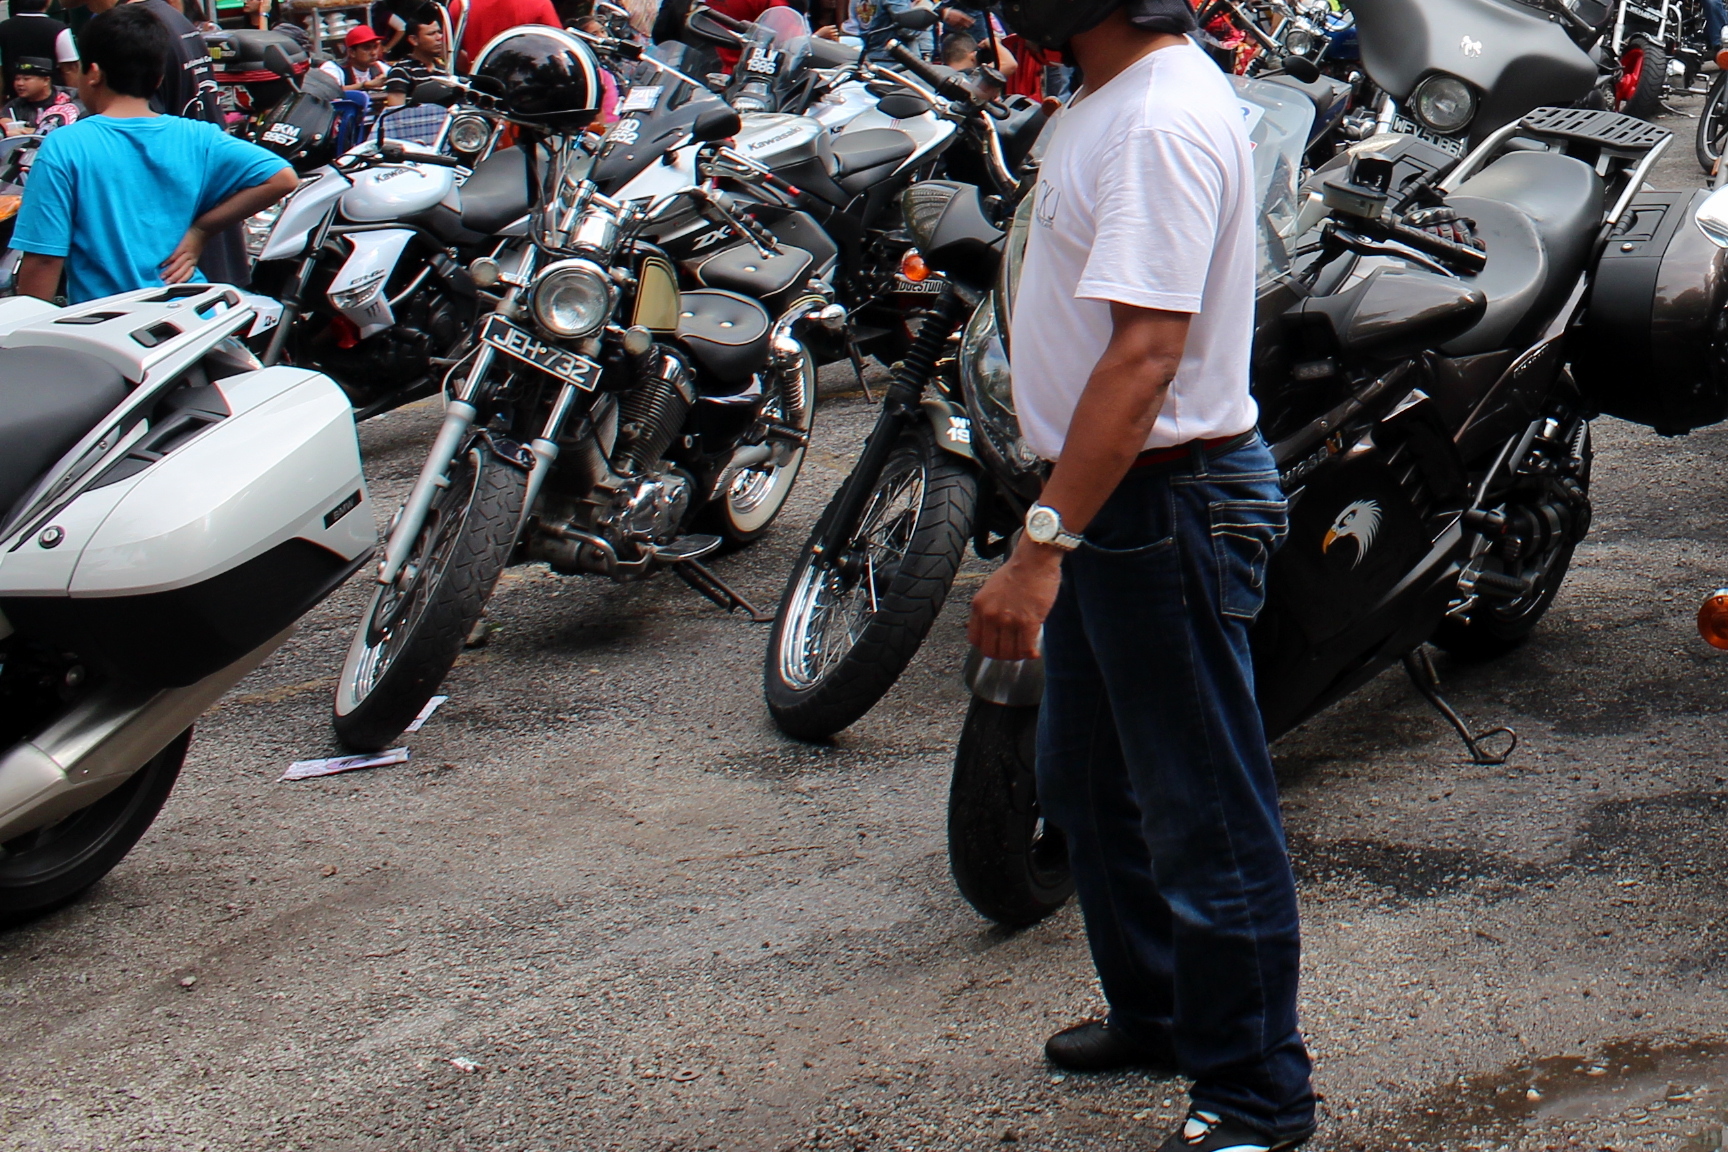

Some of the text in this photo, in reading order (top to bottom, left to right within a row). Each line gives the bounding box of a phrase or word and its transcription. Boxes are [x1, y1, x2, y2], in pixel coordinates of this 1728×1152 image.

[747, 59, 776, 74] 1986
[271, 122, 301, 136] BKM
[749, 125, 804, 152] Kawasaki
